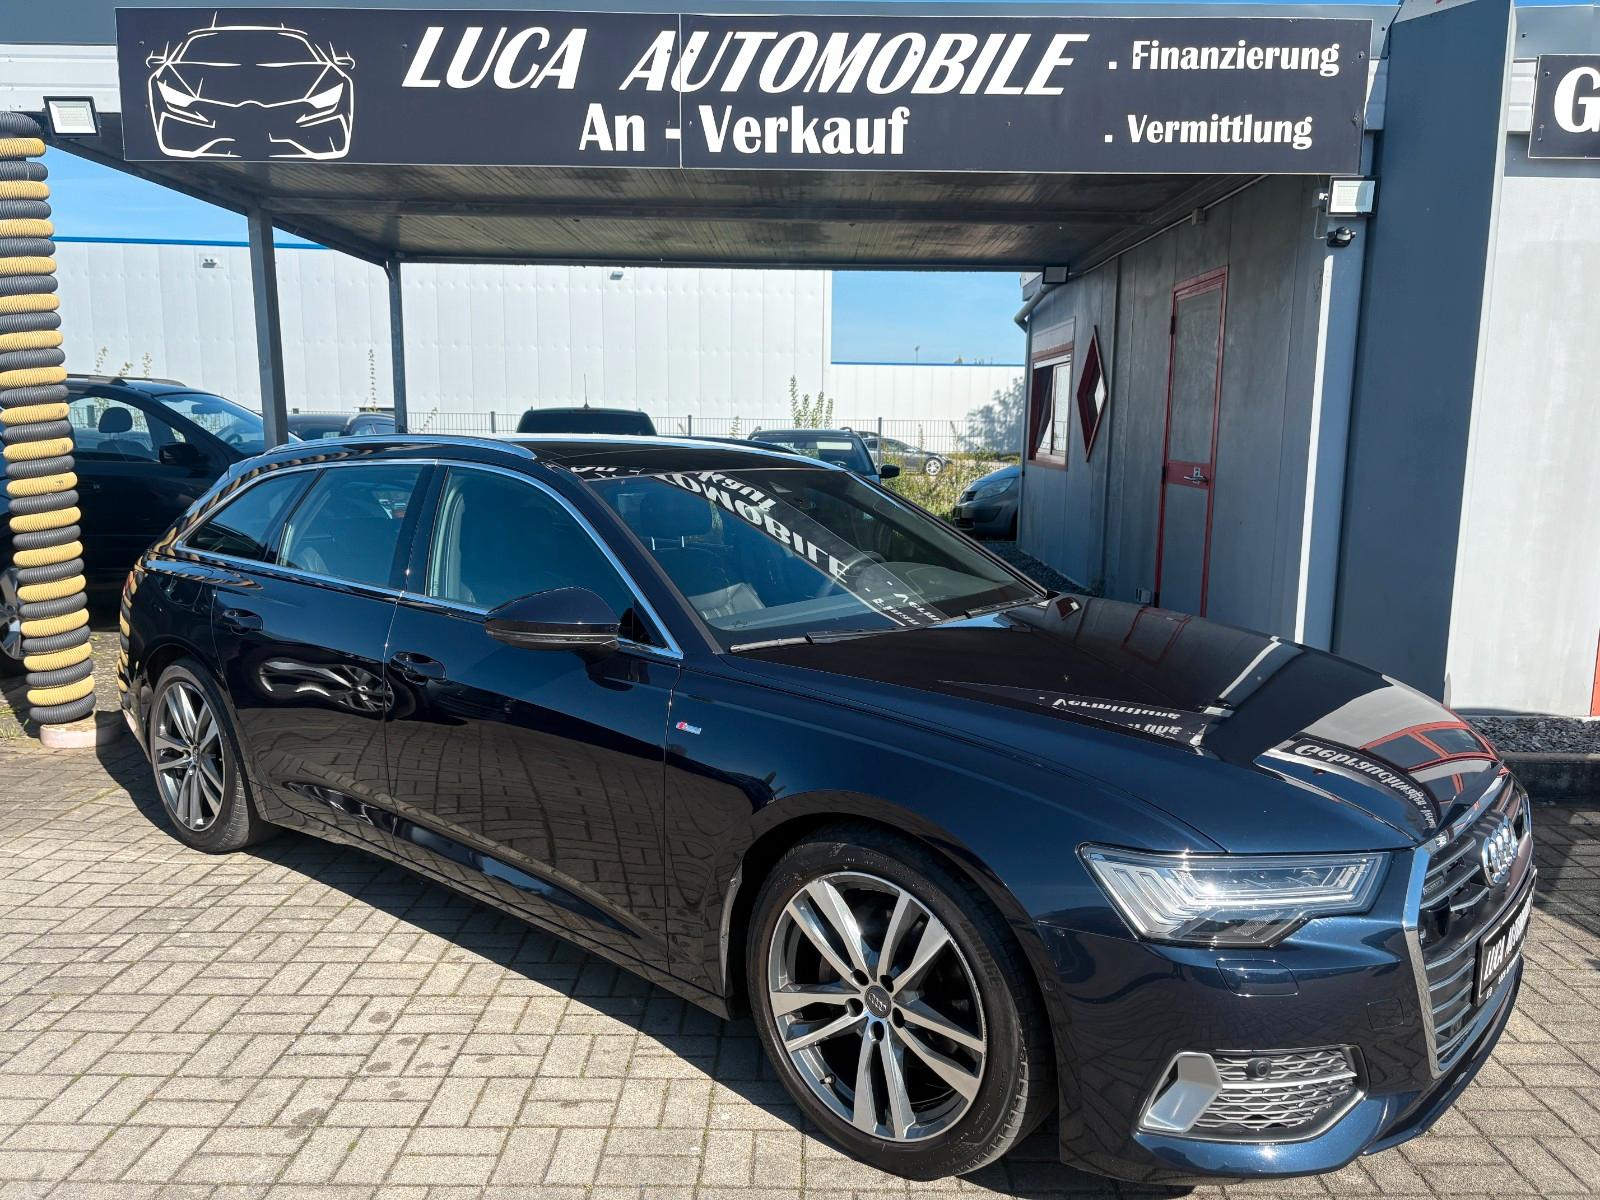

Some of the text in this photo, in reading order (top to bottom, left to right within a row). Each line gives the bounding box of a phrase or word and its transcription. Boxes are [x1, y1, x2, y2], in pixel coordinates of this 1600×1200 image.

[402, 26, 1091, 96] LUCA AUTOMOBILE
[1132, 40, 1340, 77] Finanzierung
[578, 102, 645, 152] An
[698, 104, 911, 155] Verkauf
[1127, 113, 1313, 150] Vermittlung
